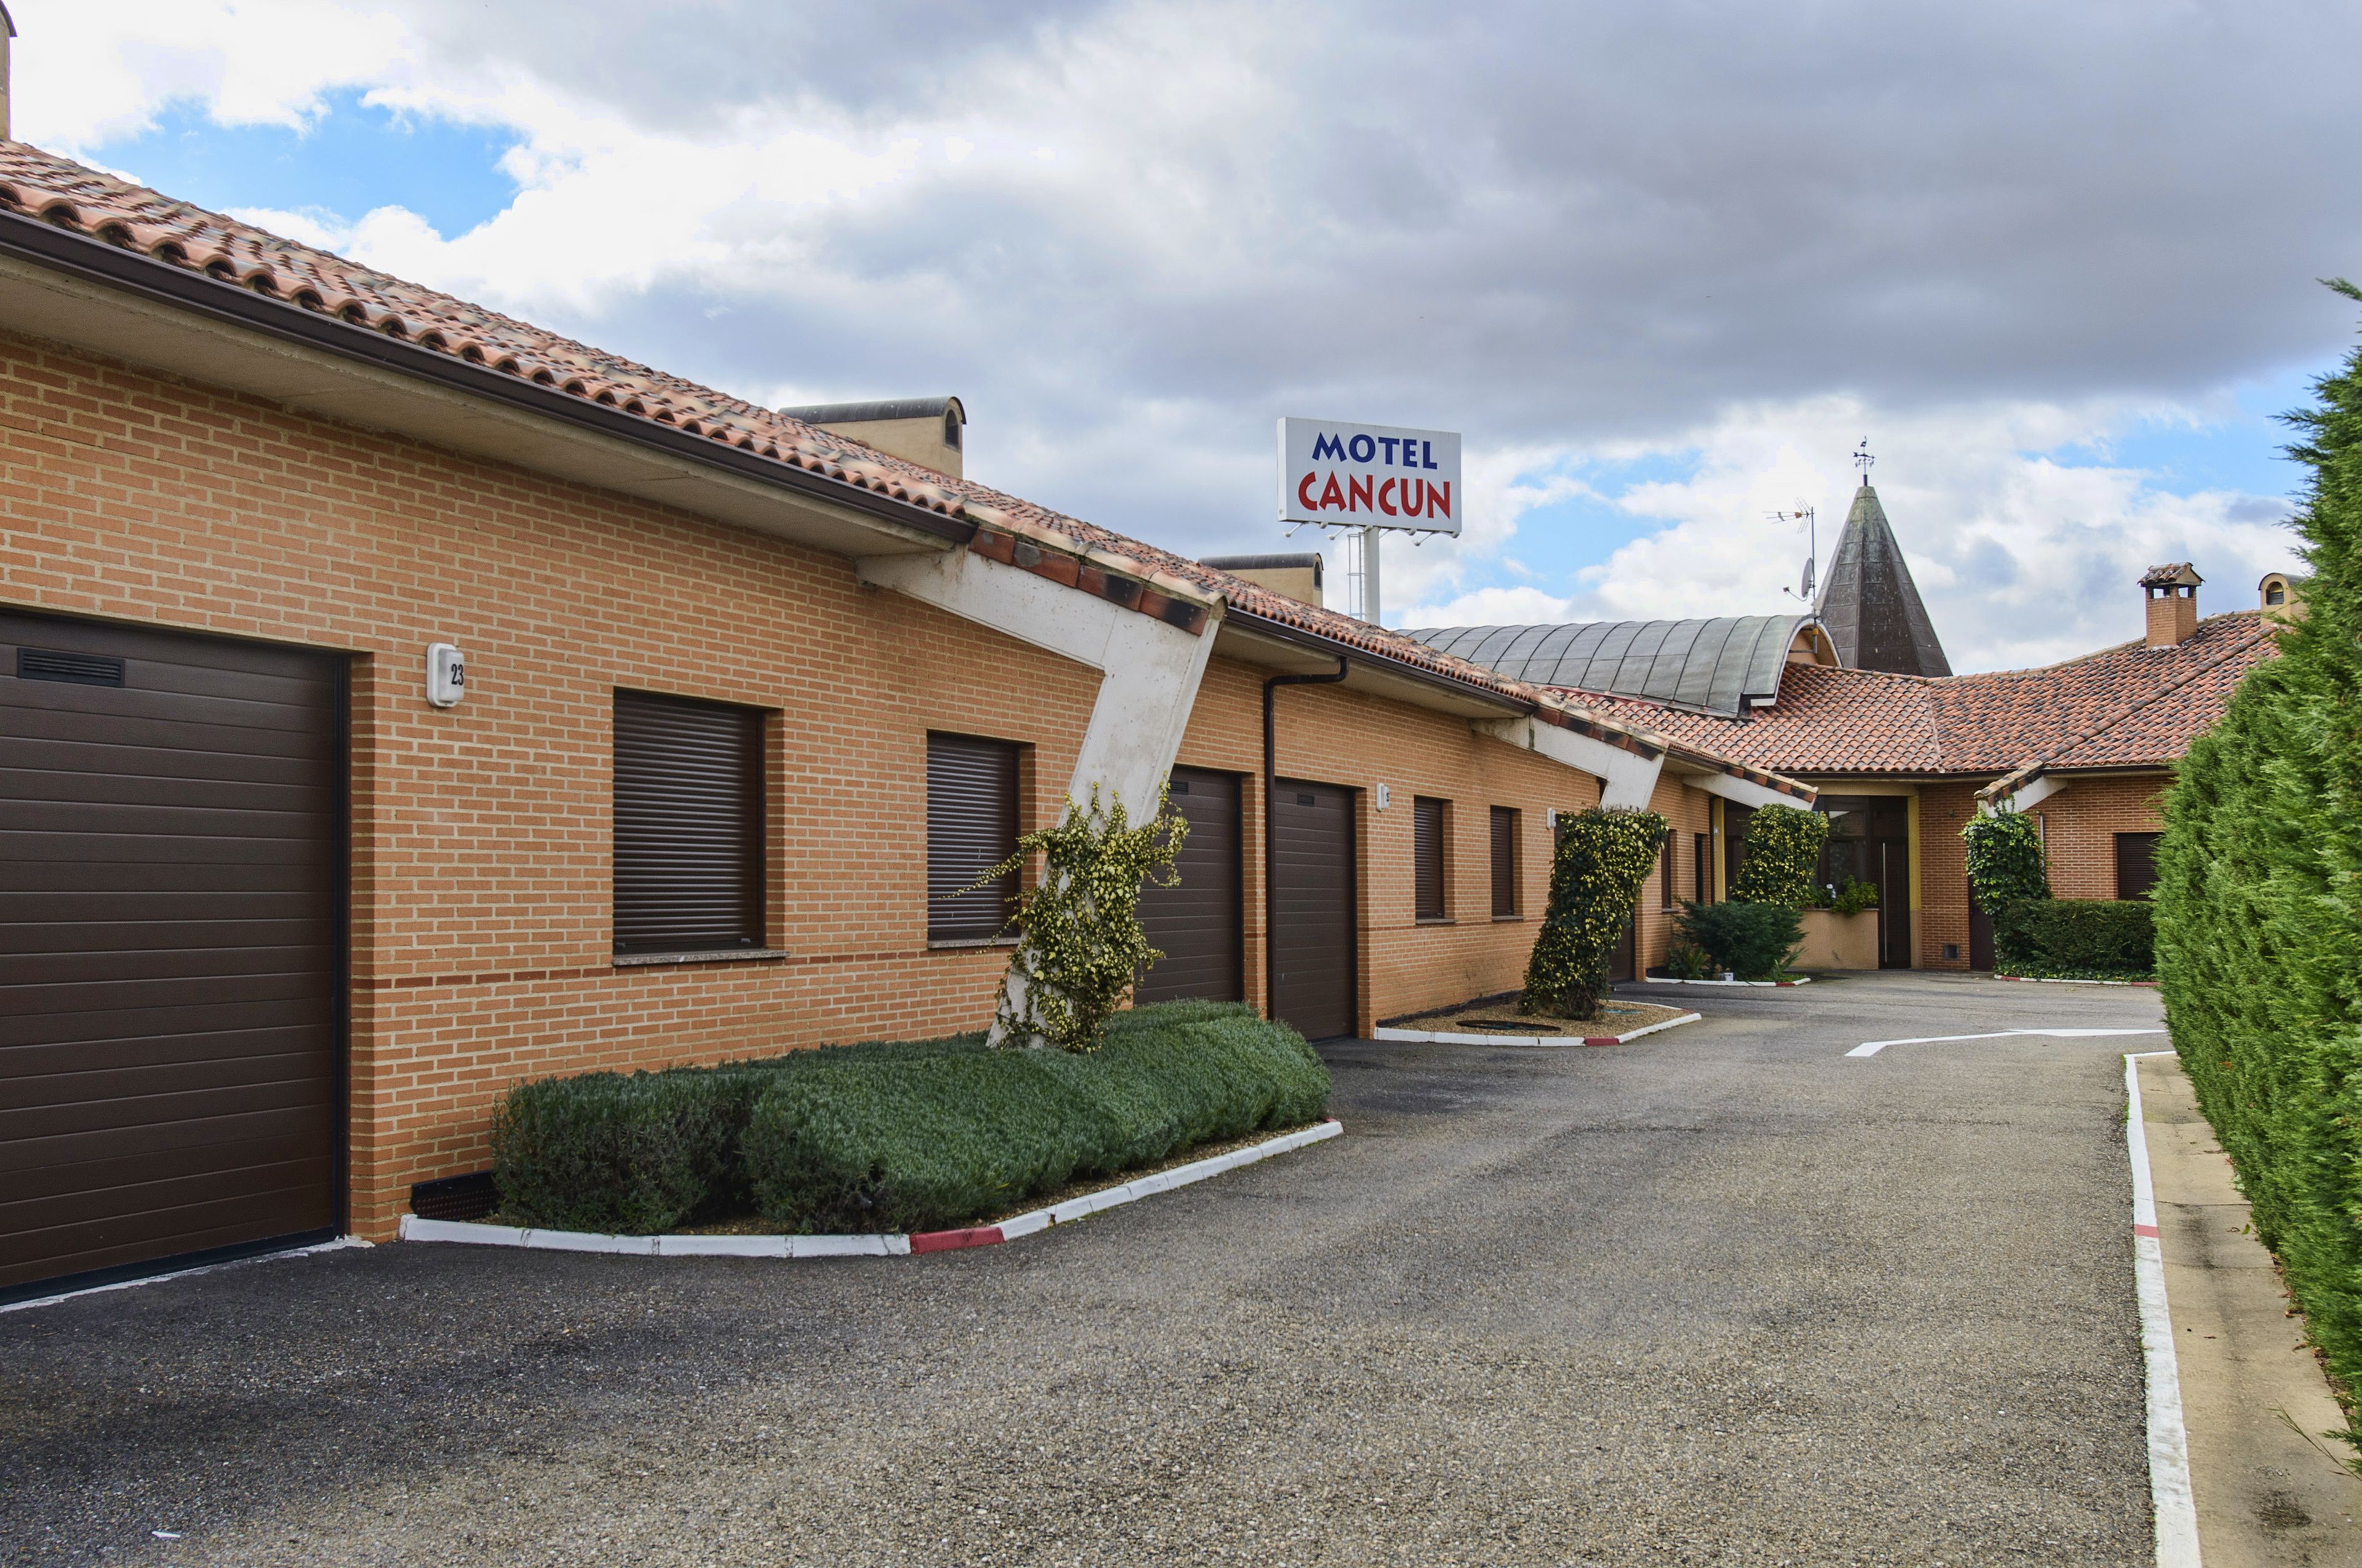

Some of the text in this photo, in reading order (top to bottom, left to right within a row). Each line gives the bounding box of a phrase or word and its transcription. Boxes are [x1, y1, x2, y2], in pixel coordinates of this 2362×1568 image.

[1311, 432, 1437, 470] MOTEL
[1298, 471, 1450, 519] CANCUN
[451, 663, 464, 686] 23
